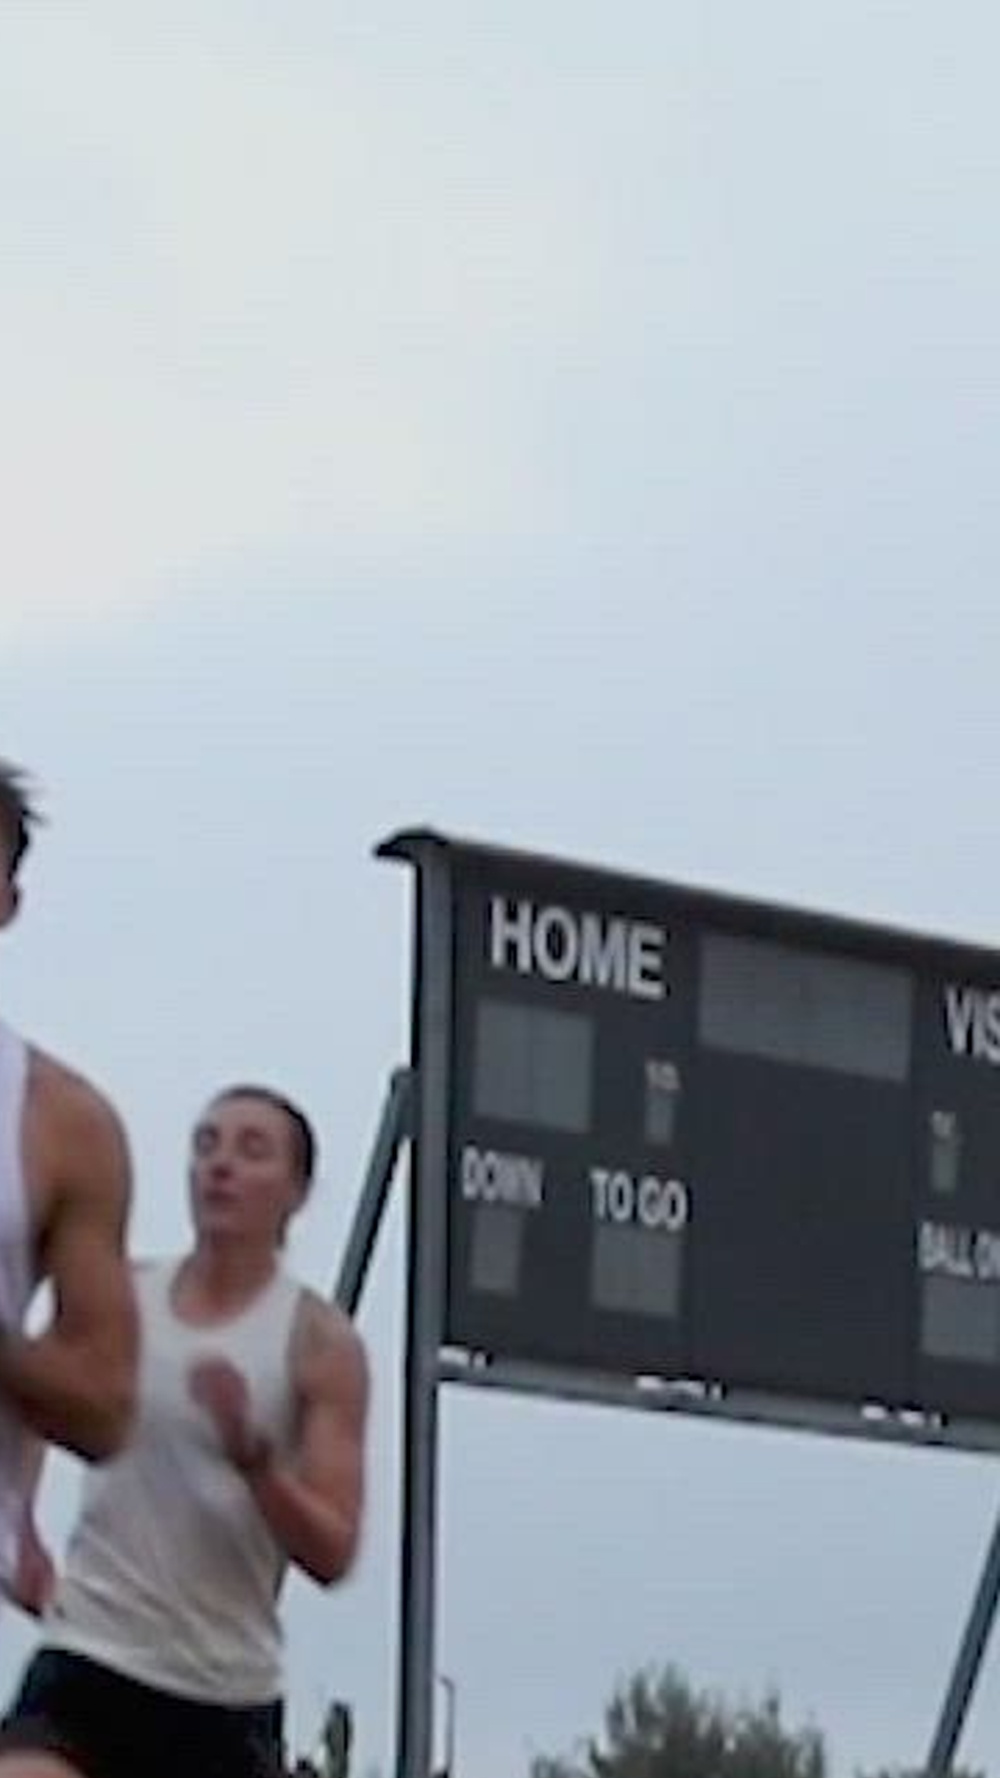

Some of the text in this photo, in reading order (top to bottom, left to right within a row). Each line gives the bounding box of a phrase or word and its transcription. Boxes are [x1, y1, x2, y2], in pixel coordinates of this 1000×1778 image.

[492, 897, 667, 1000] HOME
[462, 1146, 543, 1207] DOWN
[591, 1167, 688, 1231] TO GO
[918, 1221, 972, 1275] BALL
